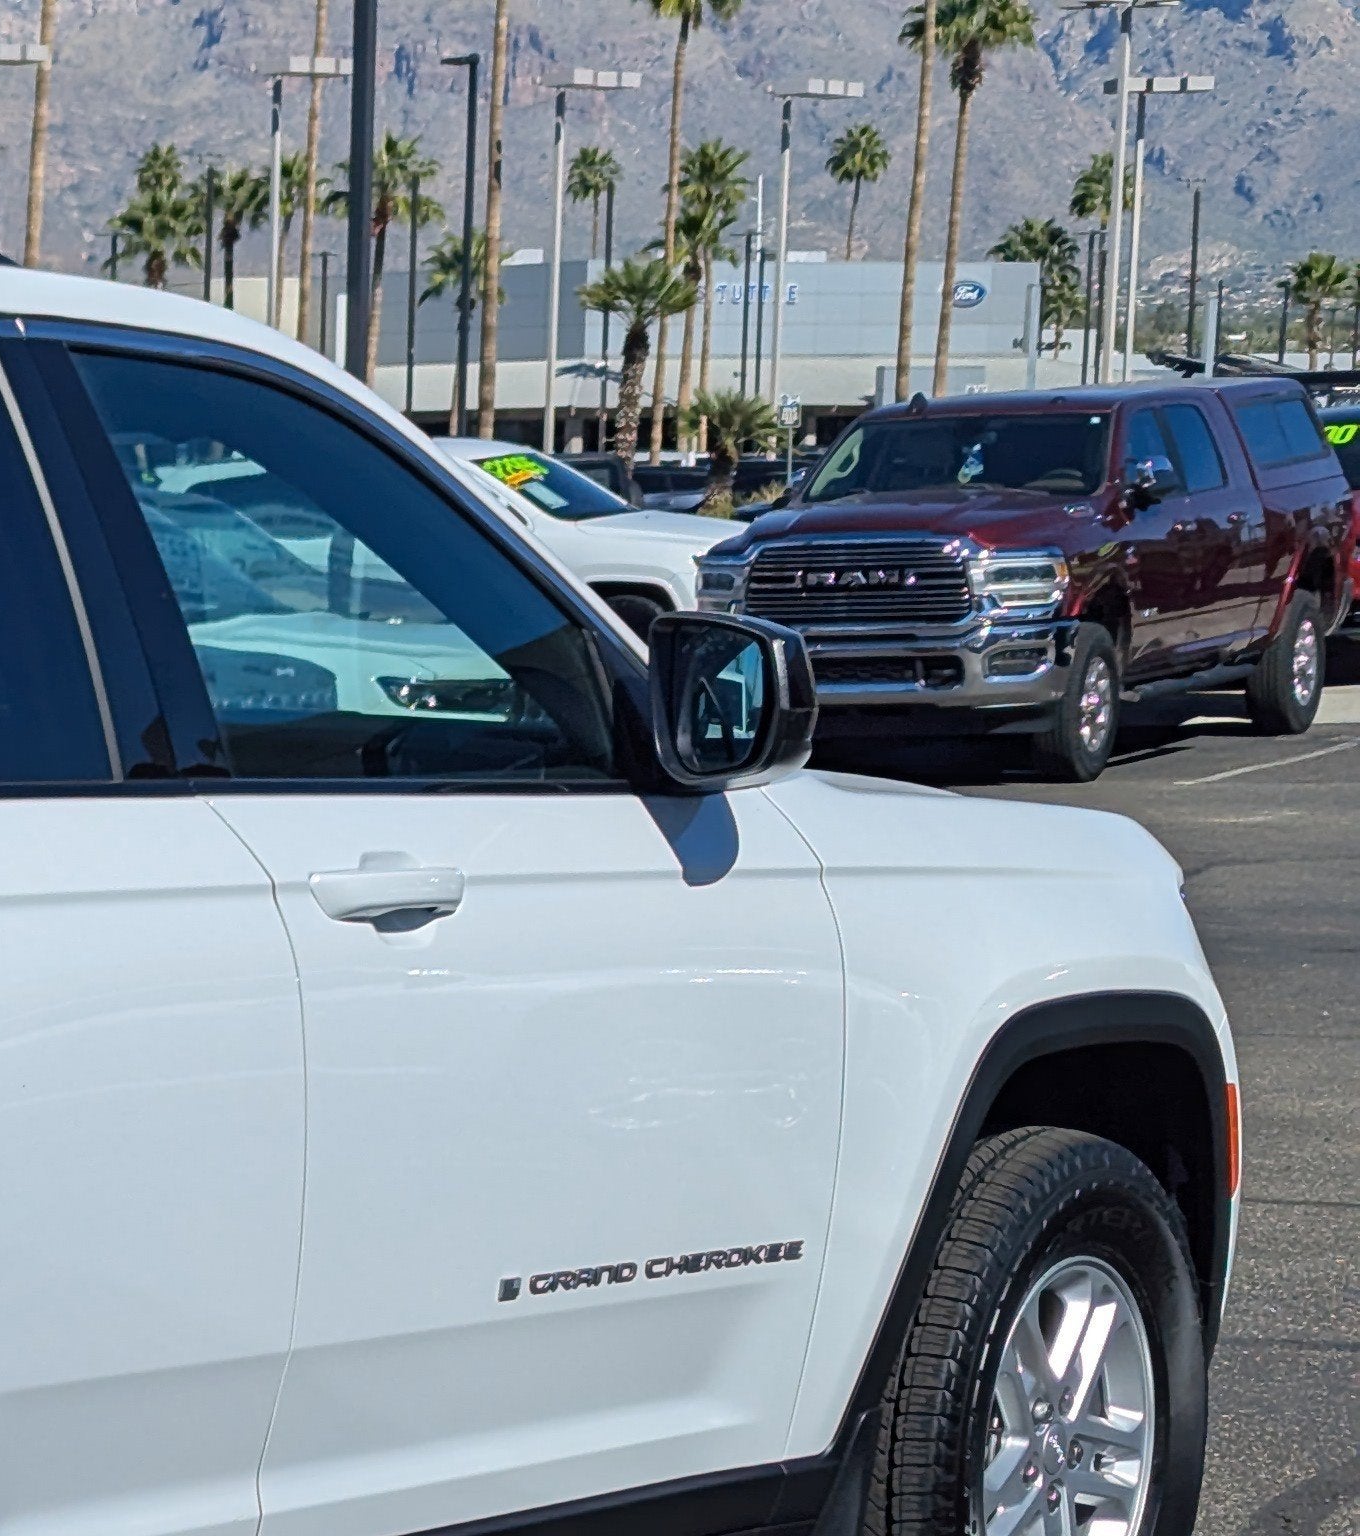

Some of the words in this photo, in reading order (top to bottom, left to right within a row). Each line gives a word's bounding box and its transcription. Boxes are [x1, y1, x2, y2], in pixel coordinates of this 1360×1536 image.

[716, 284, 799, 302] TUTTE
[954, 285, 980, 300] Ford
[806, 569, 900, 586] RAM
[528, 1261, 639, 1296] GRAND
[644, 1239, 806, 1280] CHEROKEE
